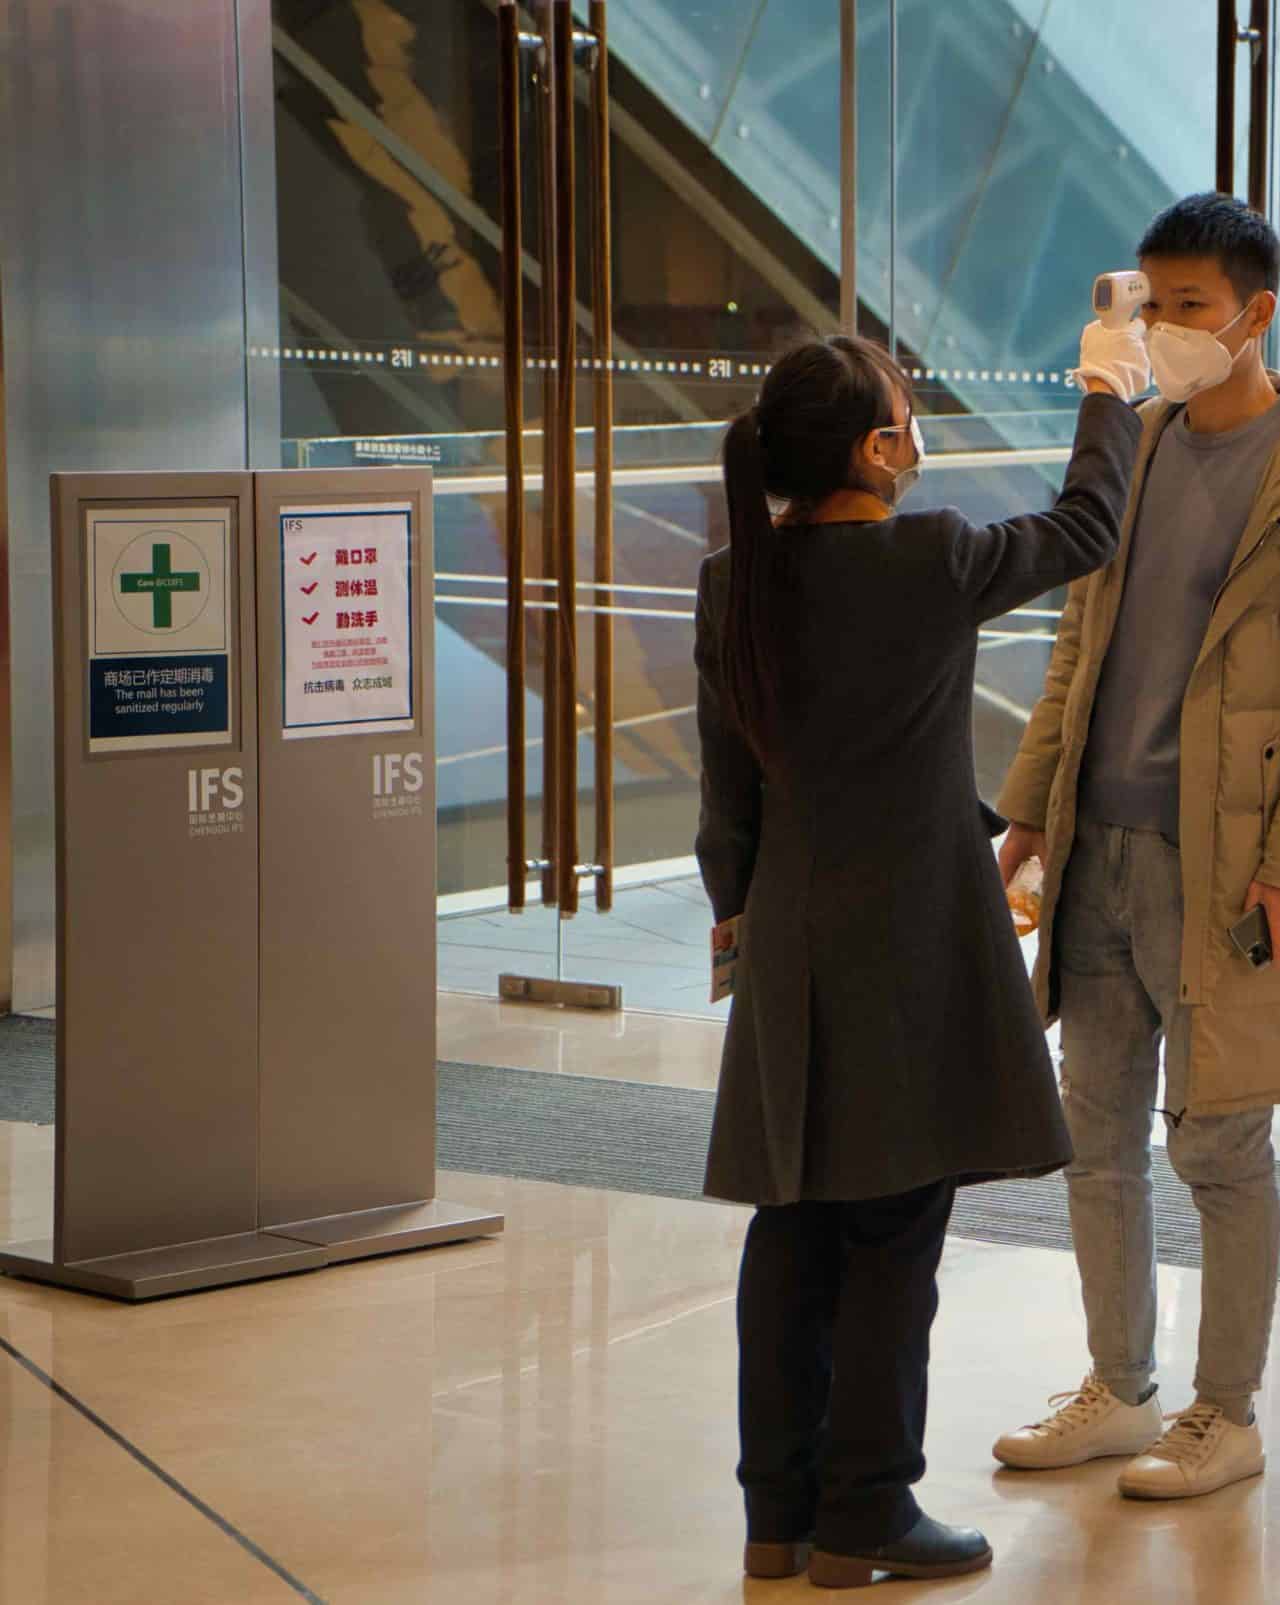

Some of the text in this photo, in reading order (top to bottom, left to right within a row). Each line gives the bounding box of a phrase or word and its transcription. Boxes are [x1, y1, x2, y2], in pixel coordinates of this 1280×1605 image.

[285, 519, 303, 532] IFS
[335, 548, 378, 565] 戴口罩
[335, 579, 378, 598] 测体温
[335, 611, 378, 629] 勤洗手
[103, 666, 214, 688] 商场已作定期消毒
[116, 687, 204, 700] The mall has been
[115, 700, 204, 715] sanitized regularly
[373, 752, 424, 795] IFS
[188, 766, 244, 812] IFS
